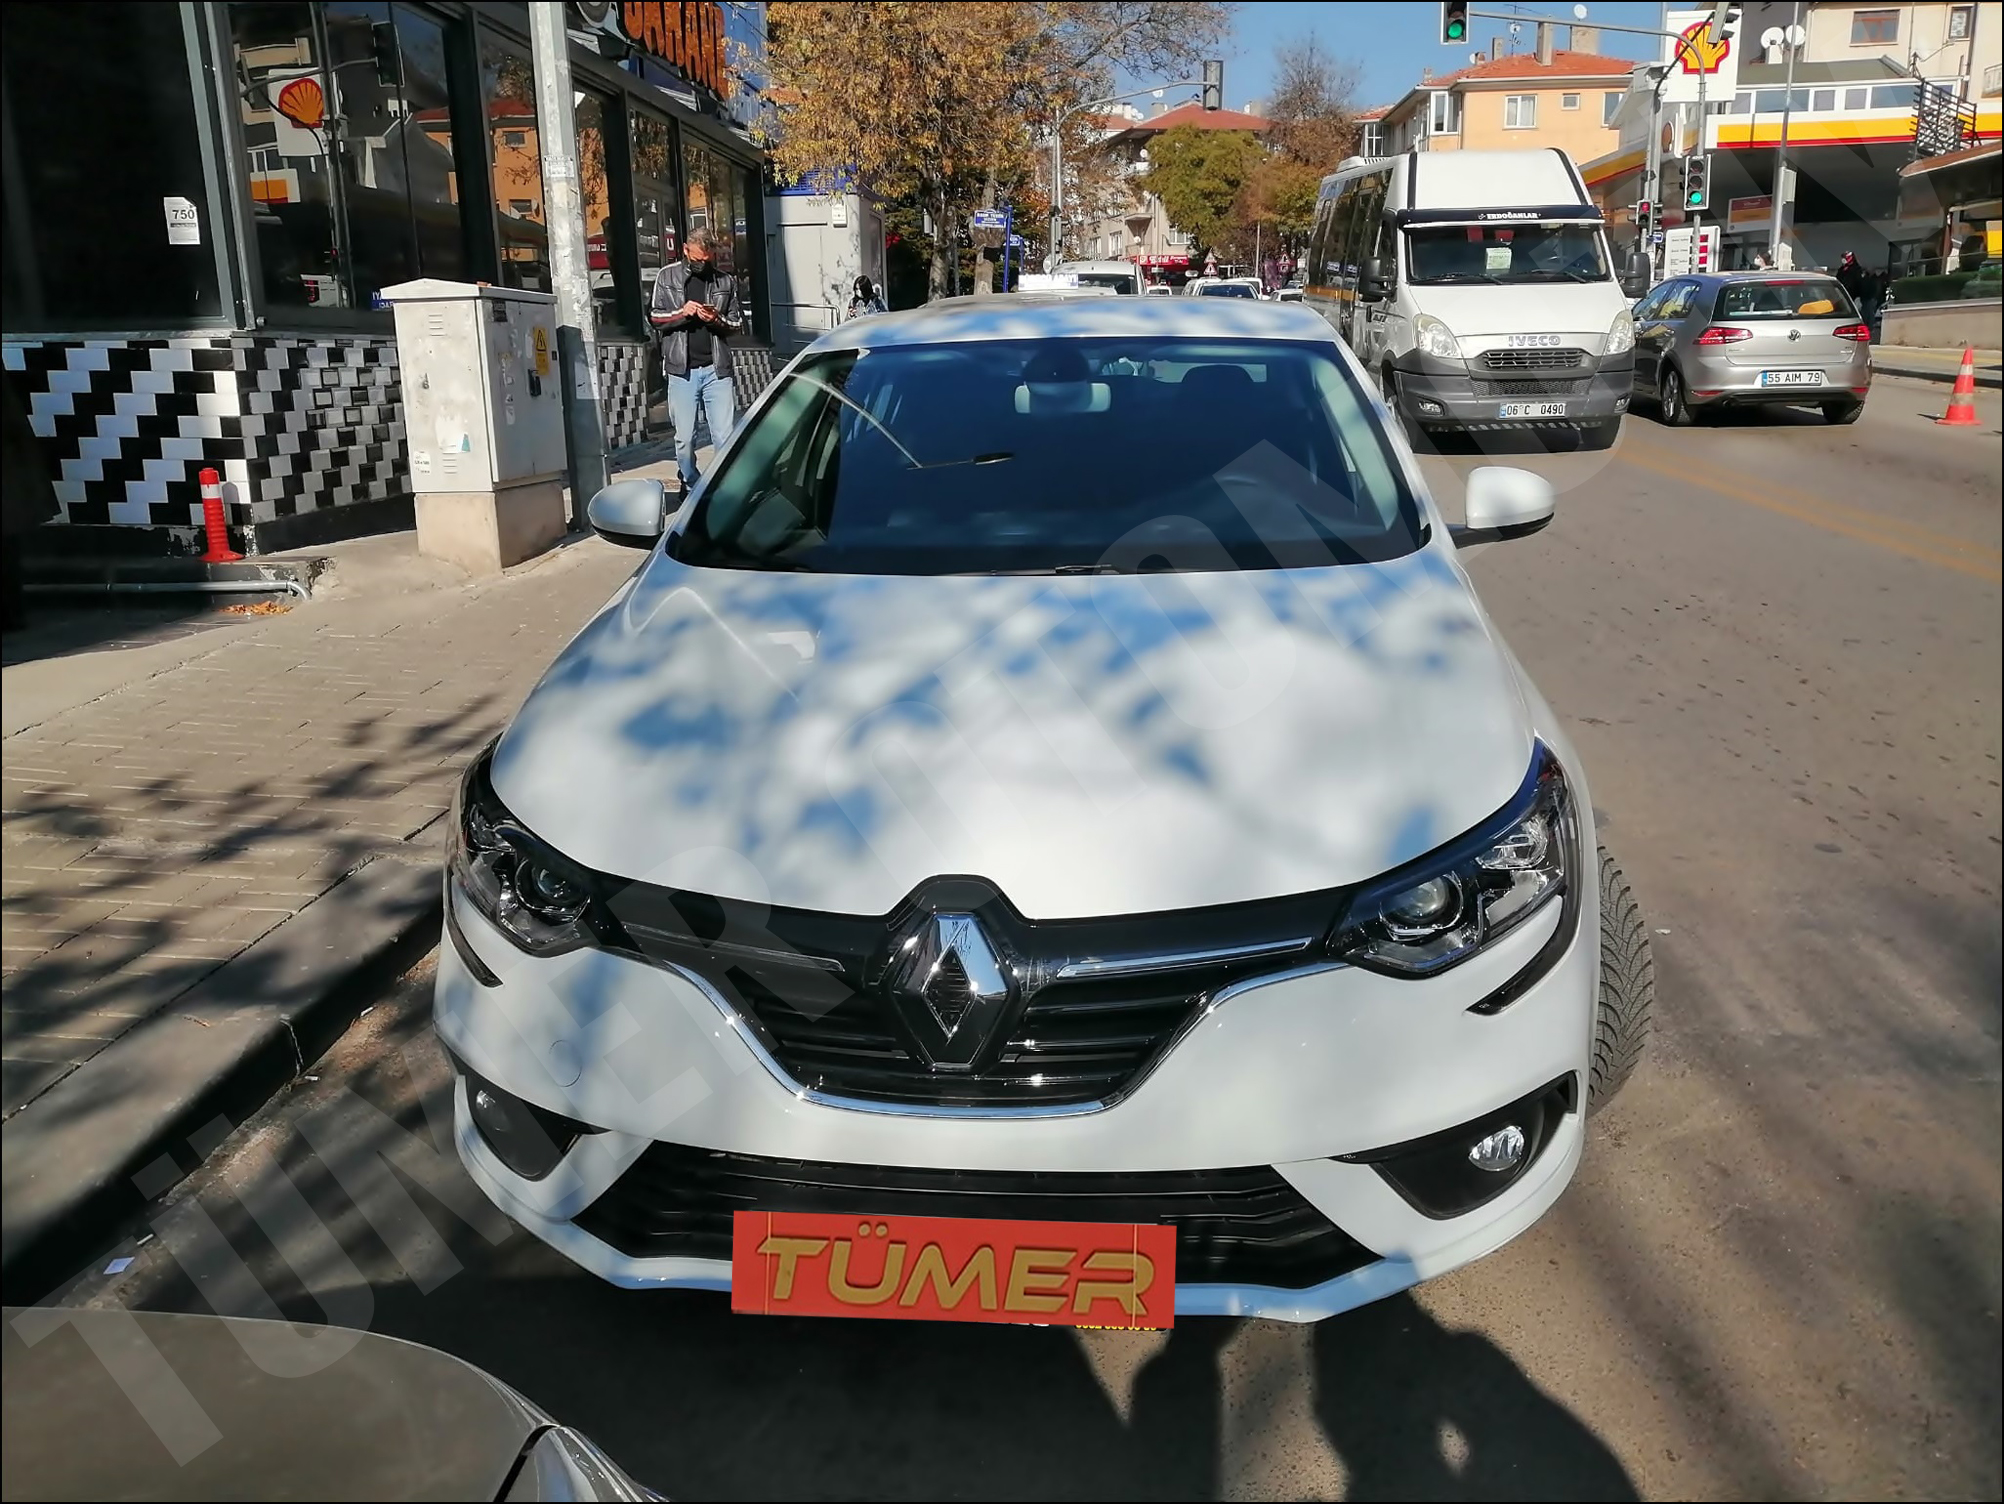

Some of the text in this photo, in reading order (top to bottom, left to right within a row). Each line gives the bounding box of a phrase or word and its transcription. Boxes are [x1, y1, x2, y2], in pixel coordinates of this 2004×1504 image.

[172, 209, 195, 220] 750
[1487, 211, 1539, 220] ERDOĞANLAR
[1508, 335, 1561, 347] IVECO
[1767, 372, 1820, 383] 55 AIM 79
[1507, 403, 1564, 416] 06 C 0490
